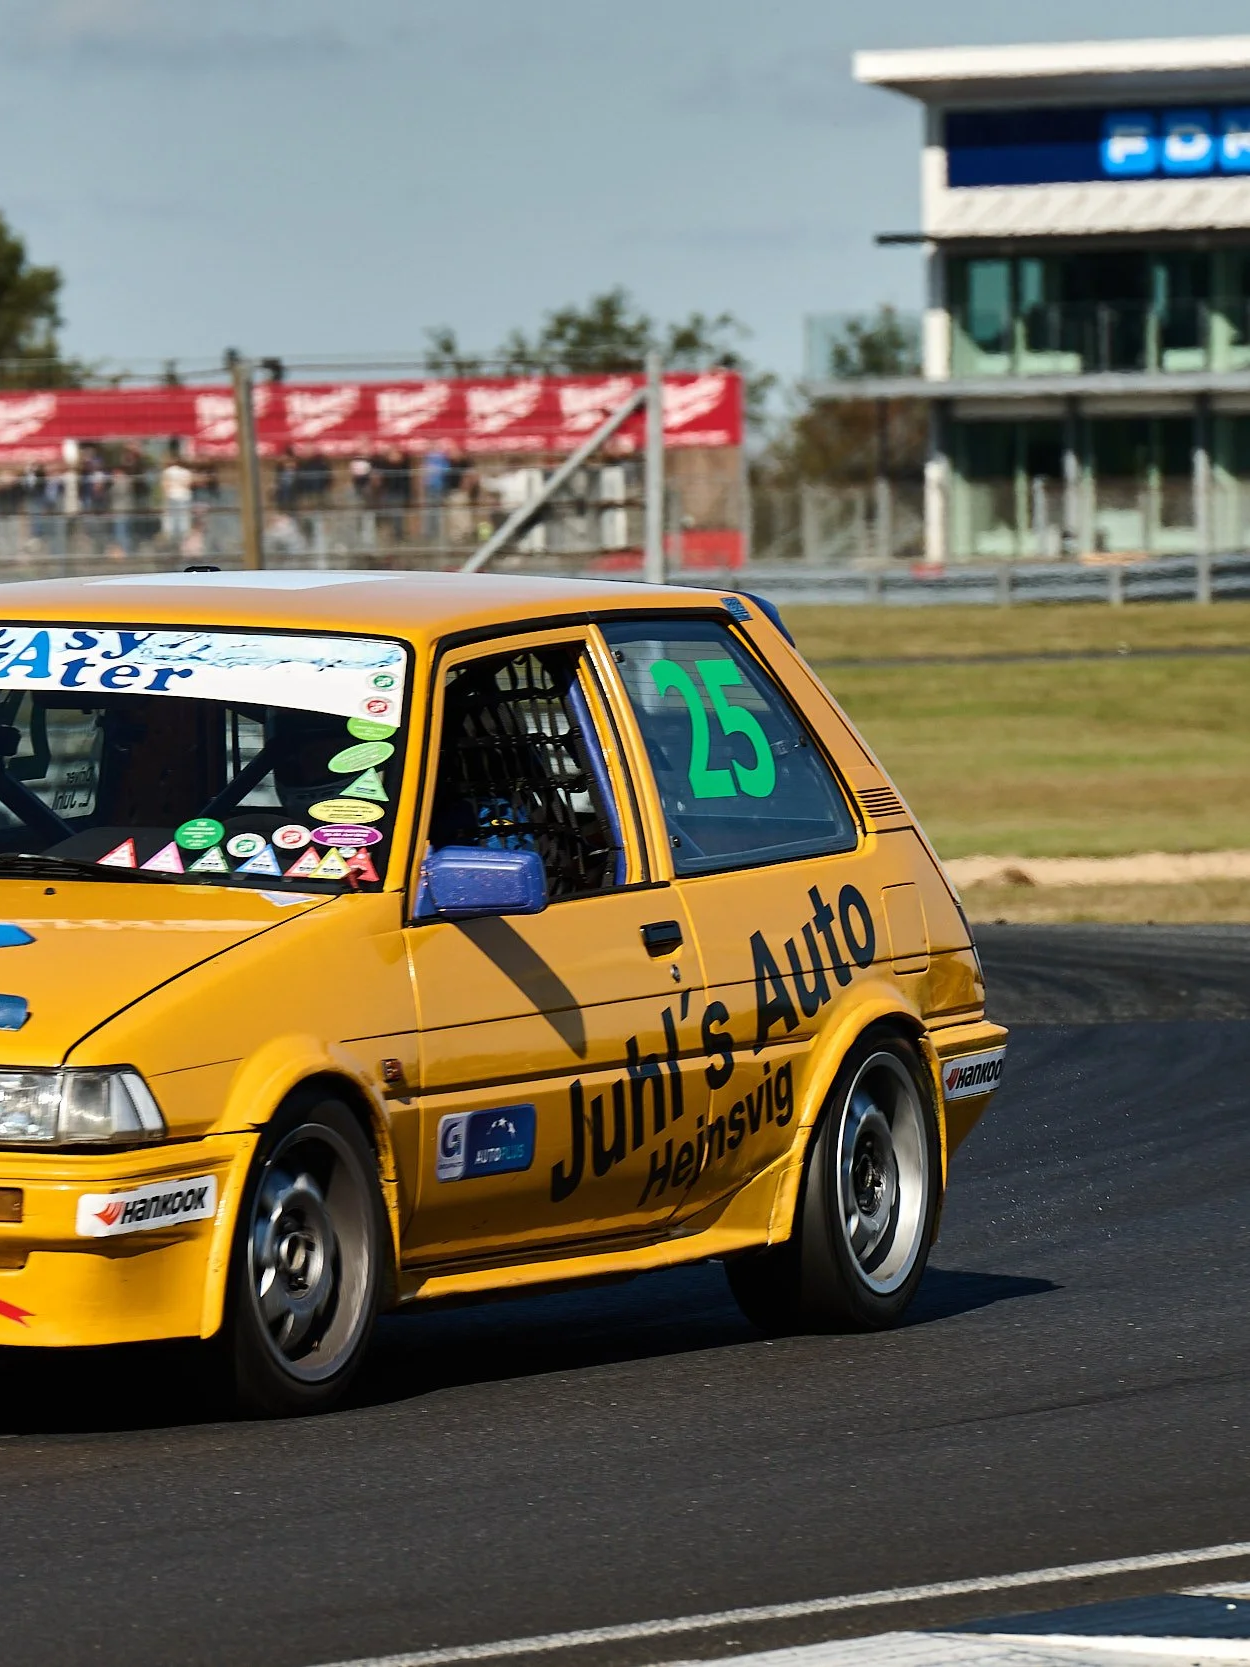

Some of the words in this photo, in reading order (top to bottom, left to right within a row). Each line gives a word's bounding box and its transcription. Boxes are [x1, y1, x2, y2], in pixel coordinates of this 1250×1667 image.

[650, 658, 777, 799] 25
[551, 987, 735, 1203] Juhl's
[750, 884, 876, 1055] Auto
[955, 1058, 1003, 1090] Hankoo
[637, 1060, 793, 1208] Hejnsvig
